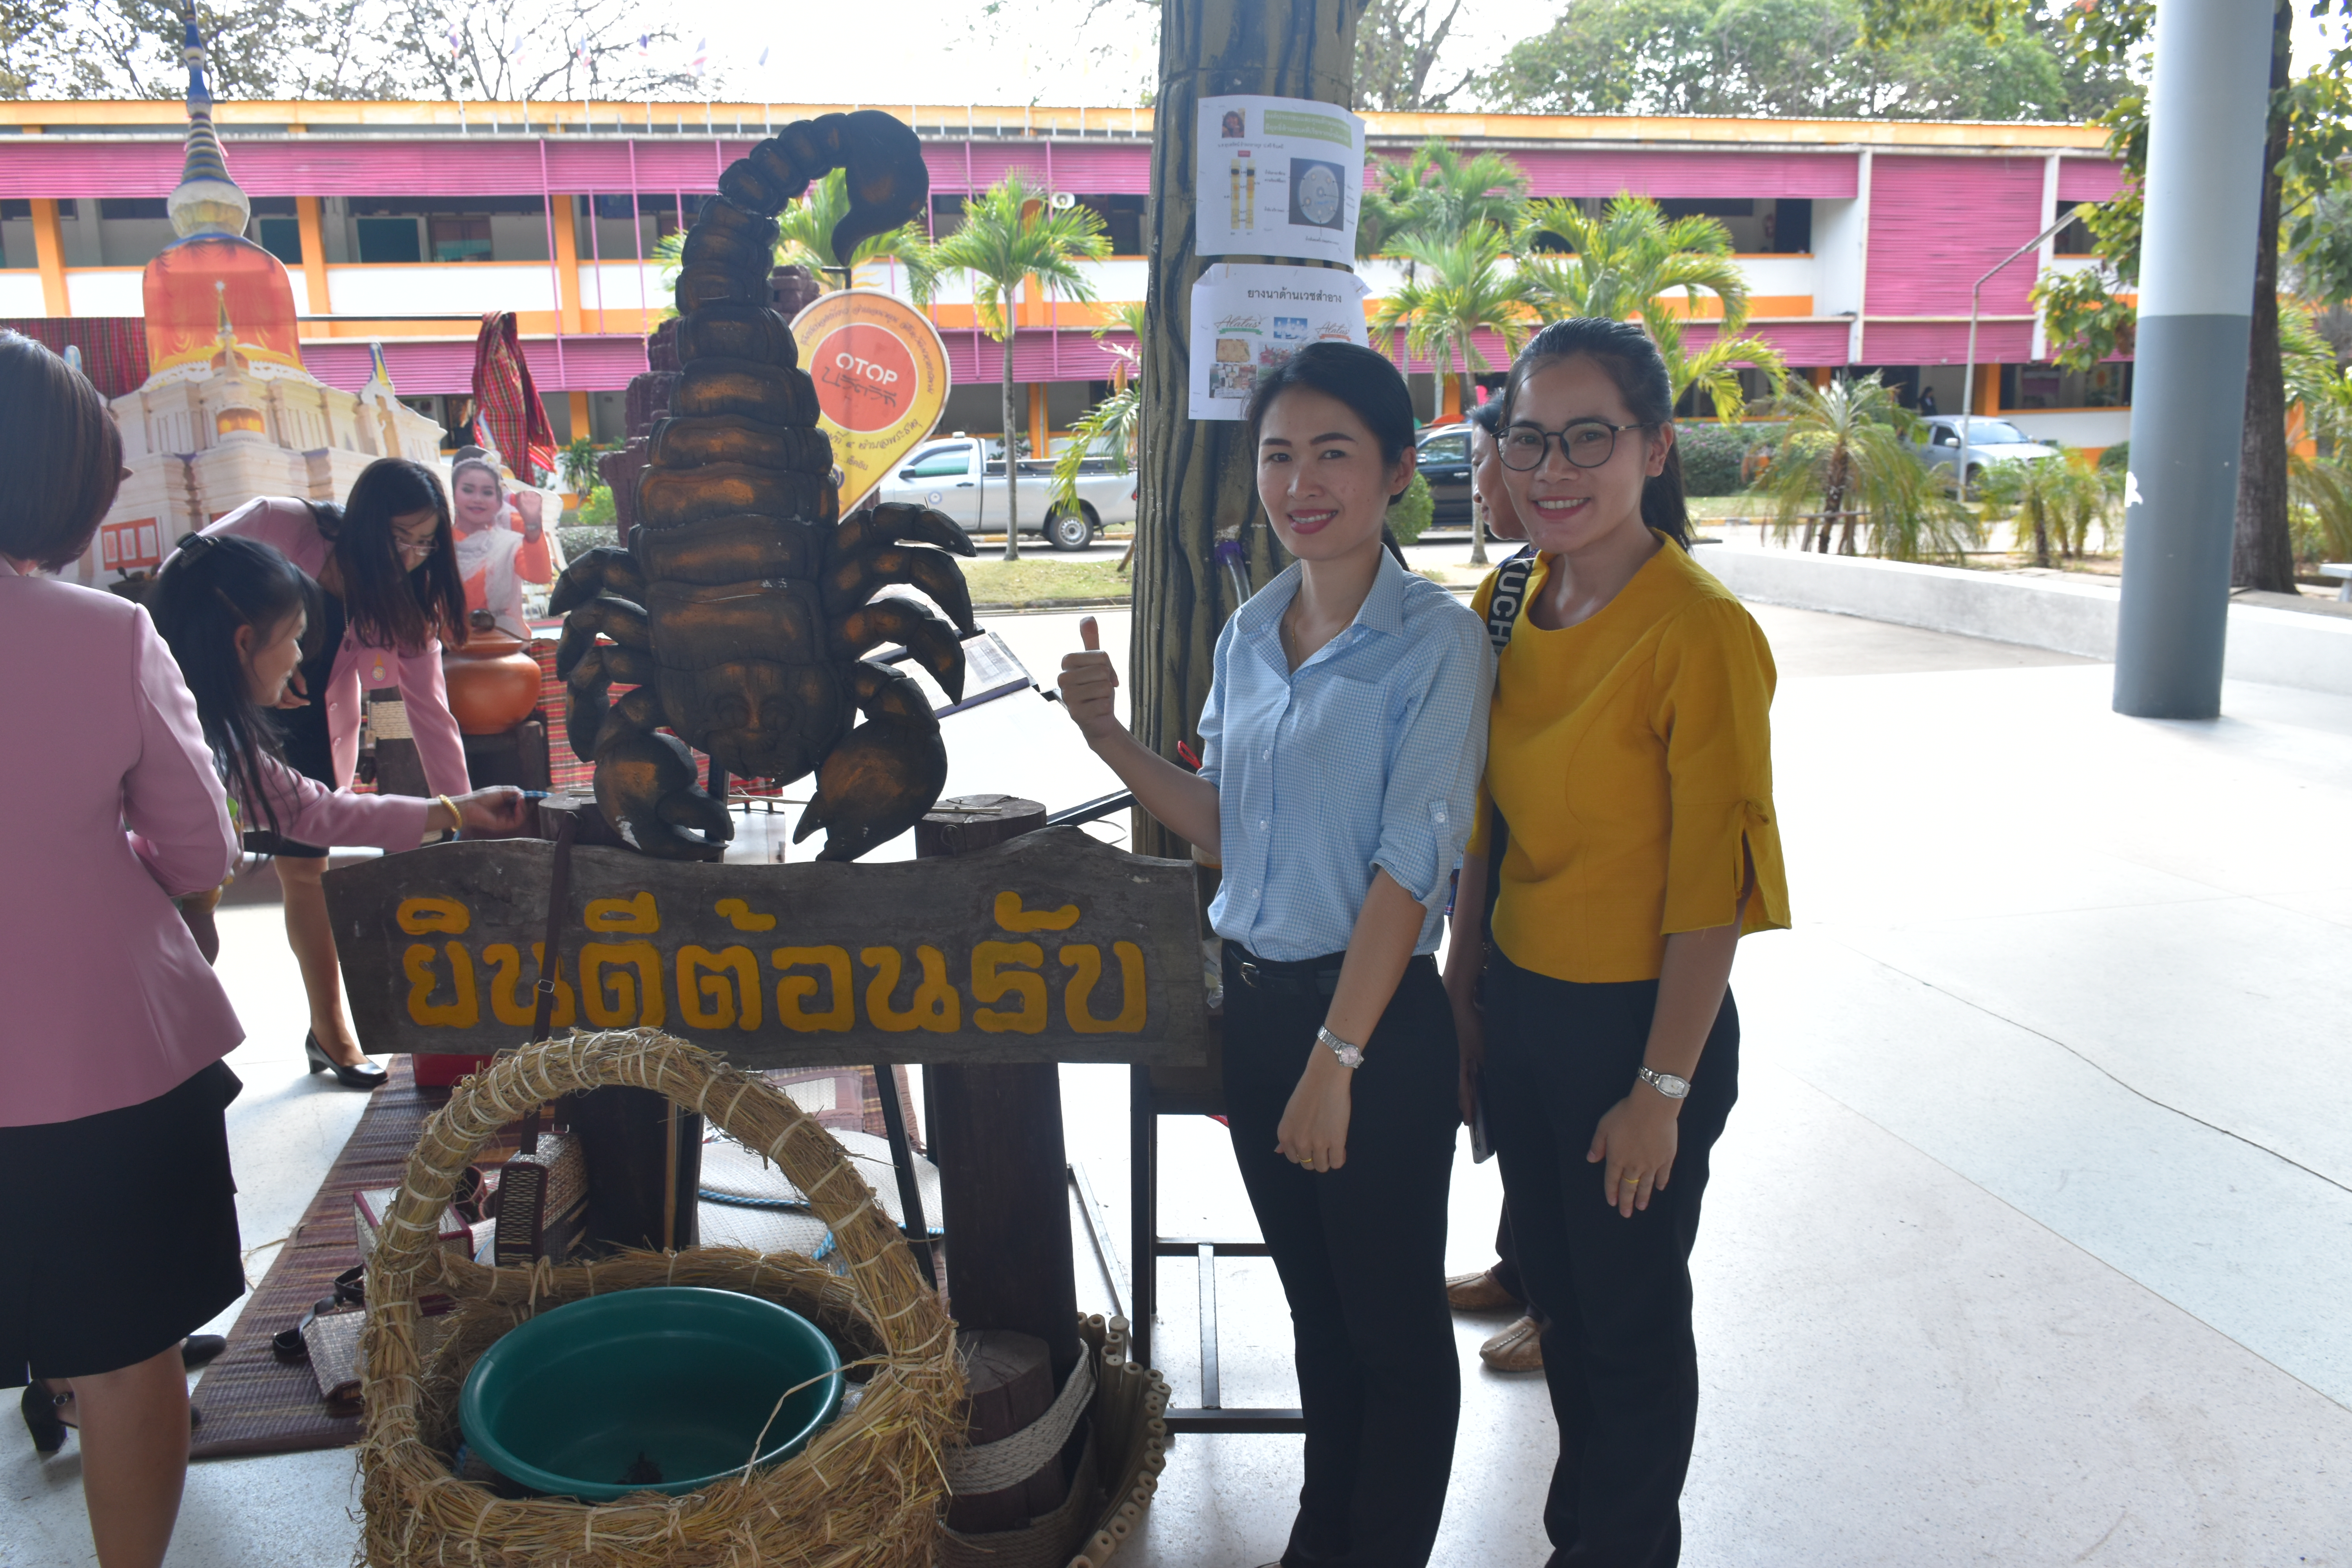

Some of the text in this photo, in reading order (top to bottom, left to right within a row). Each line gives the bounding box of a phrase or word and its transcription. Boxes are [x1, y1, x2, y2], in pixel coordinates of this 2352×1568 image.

[1247, 287, 1341, 303] ยางนาด้านเวชสำอาง
[1214, 314, 1258, 328] Alatus
[1315, 321, 1350, 335] Alatus
[836, 353, 898, 385] OTOP
[396, 891, 1147, 1034] ยินดีต้อนรับ
